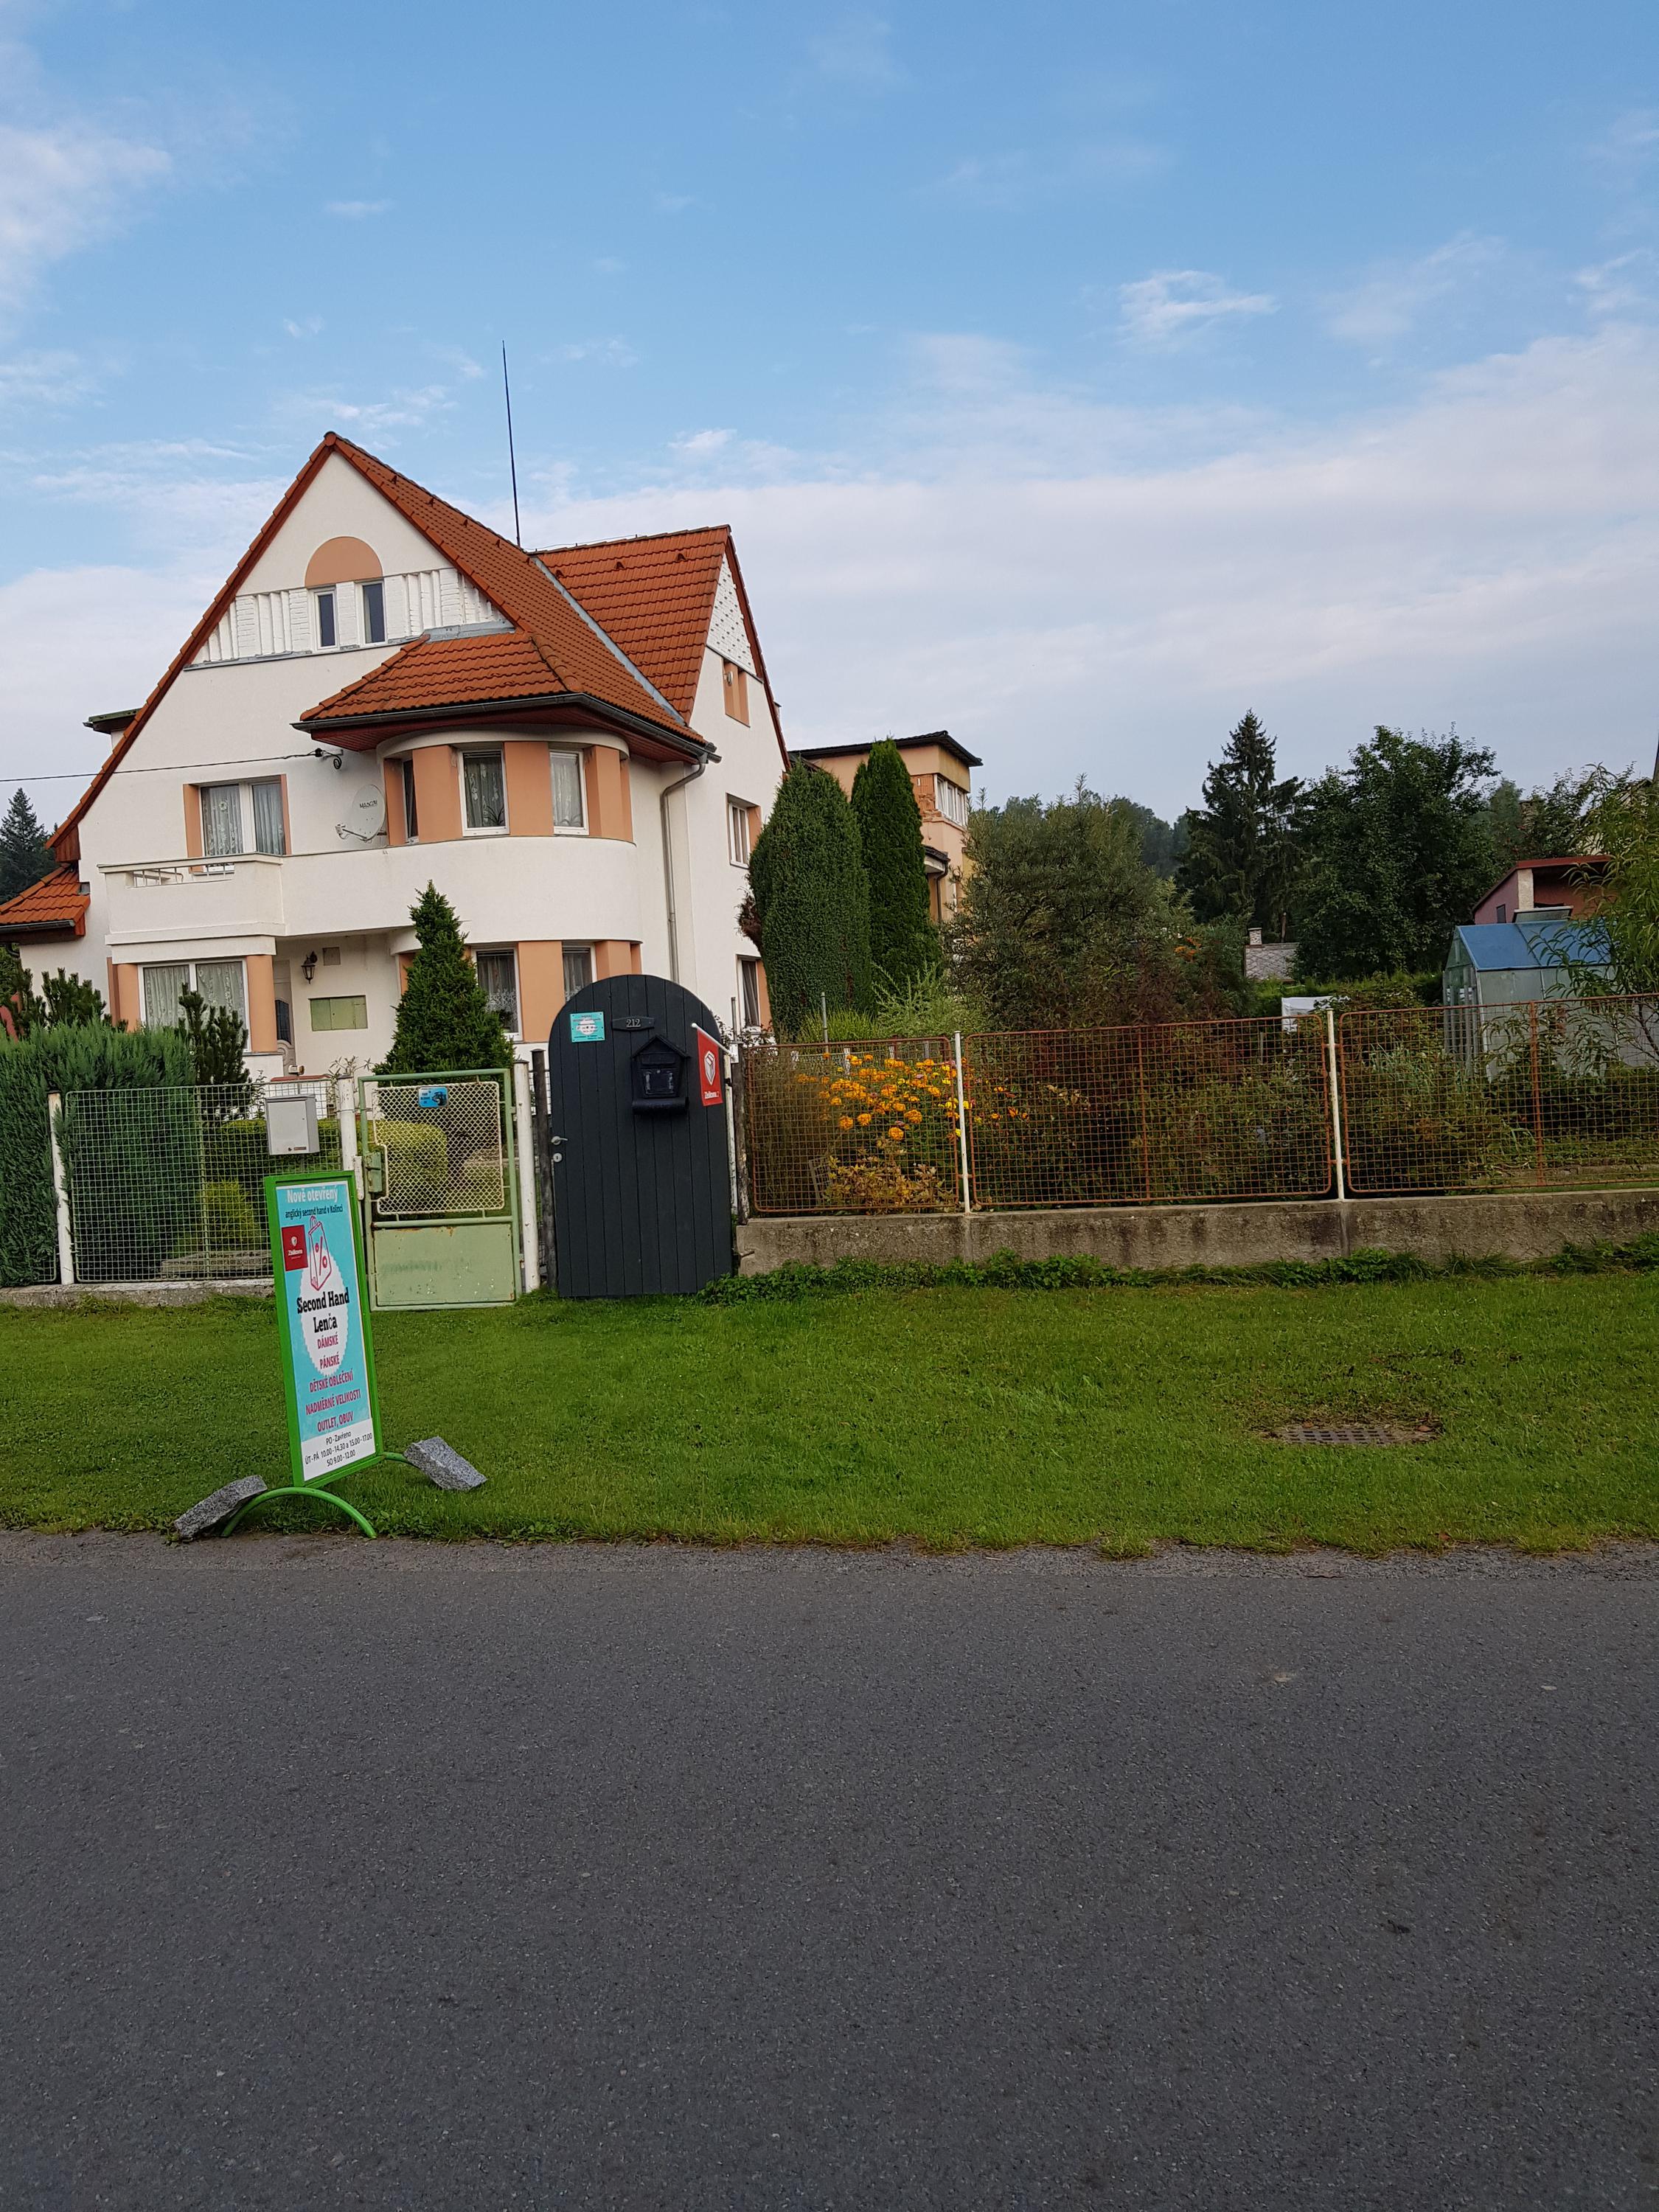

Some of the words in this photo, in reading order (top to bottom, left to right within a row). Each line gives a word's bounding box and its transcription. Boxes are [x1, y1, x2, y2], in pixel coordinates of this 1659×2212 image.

[626, 1018, 641, 1027] 212
[287, 1188, 306, 1203] Nově
[307, 1185, 338, 1203] otevřený
[285, 1208, 301, 1220] anglický
[302, 1207, 316, 1216] second
[316, 1206, 326, 1215] hand
[297, 1291, 327, 1314] Second
[328, 1287, 349, 1308] Hand
[313, 1313, 338, 1333] Lenča
[317, 1331, 338, 1349] DÁMSKÉ
[320, 1351, 340, 1369] PÁNSKÉ
[309, 1375, 328, 1393] DĚTSKÉ
[329, 1368, 353, 1387] OBLEČENÍ
[305, 1394, 335, 1415] NADMĚRNÉ
[335, 1389, 361, 1405] VELIKOSTI
[317, 1415, 339, 1432] OUTLET,
[339, 1411, 354, 1425] OBUV
[326, 1437, 332, 1445] PO
[335, 1431, 351, 1442] Zavřeno
[326, 1458, 333, 1467] SO
